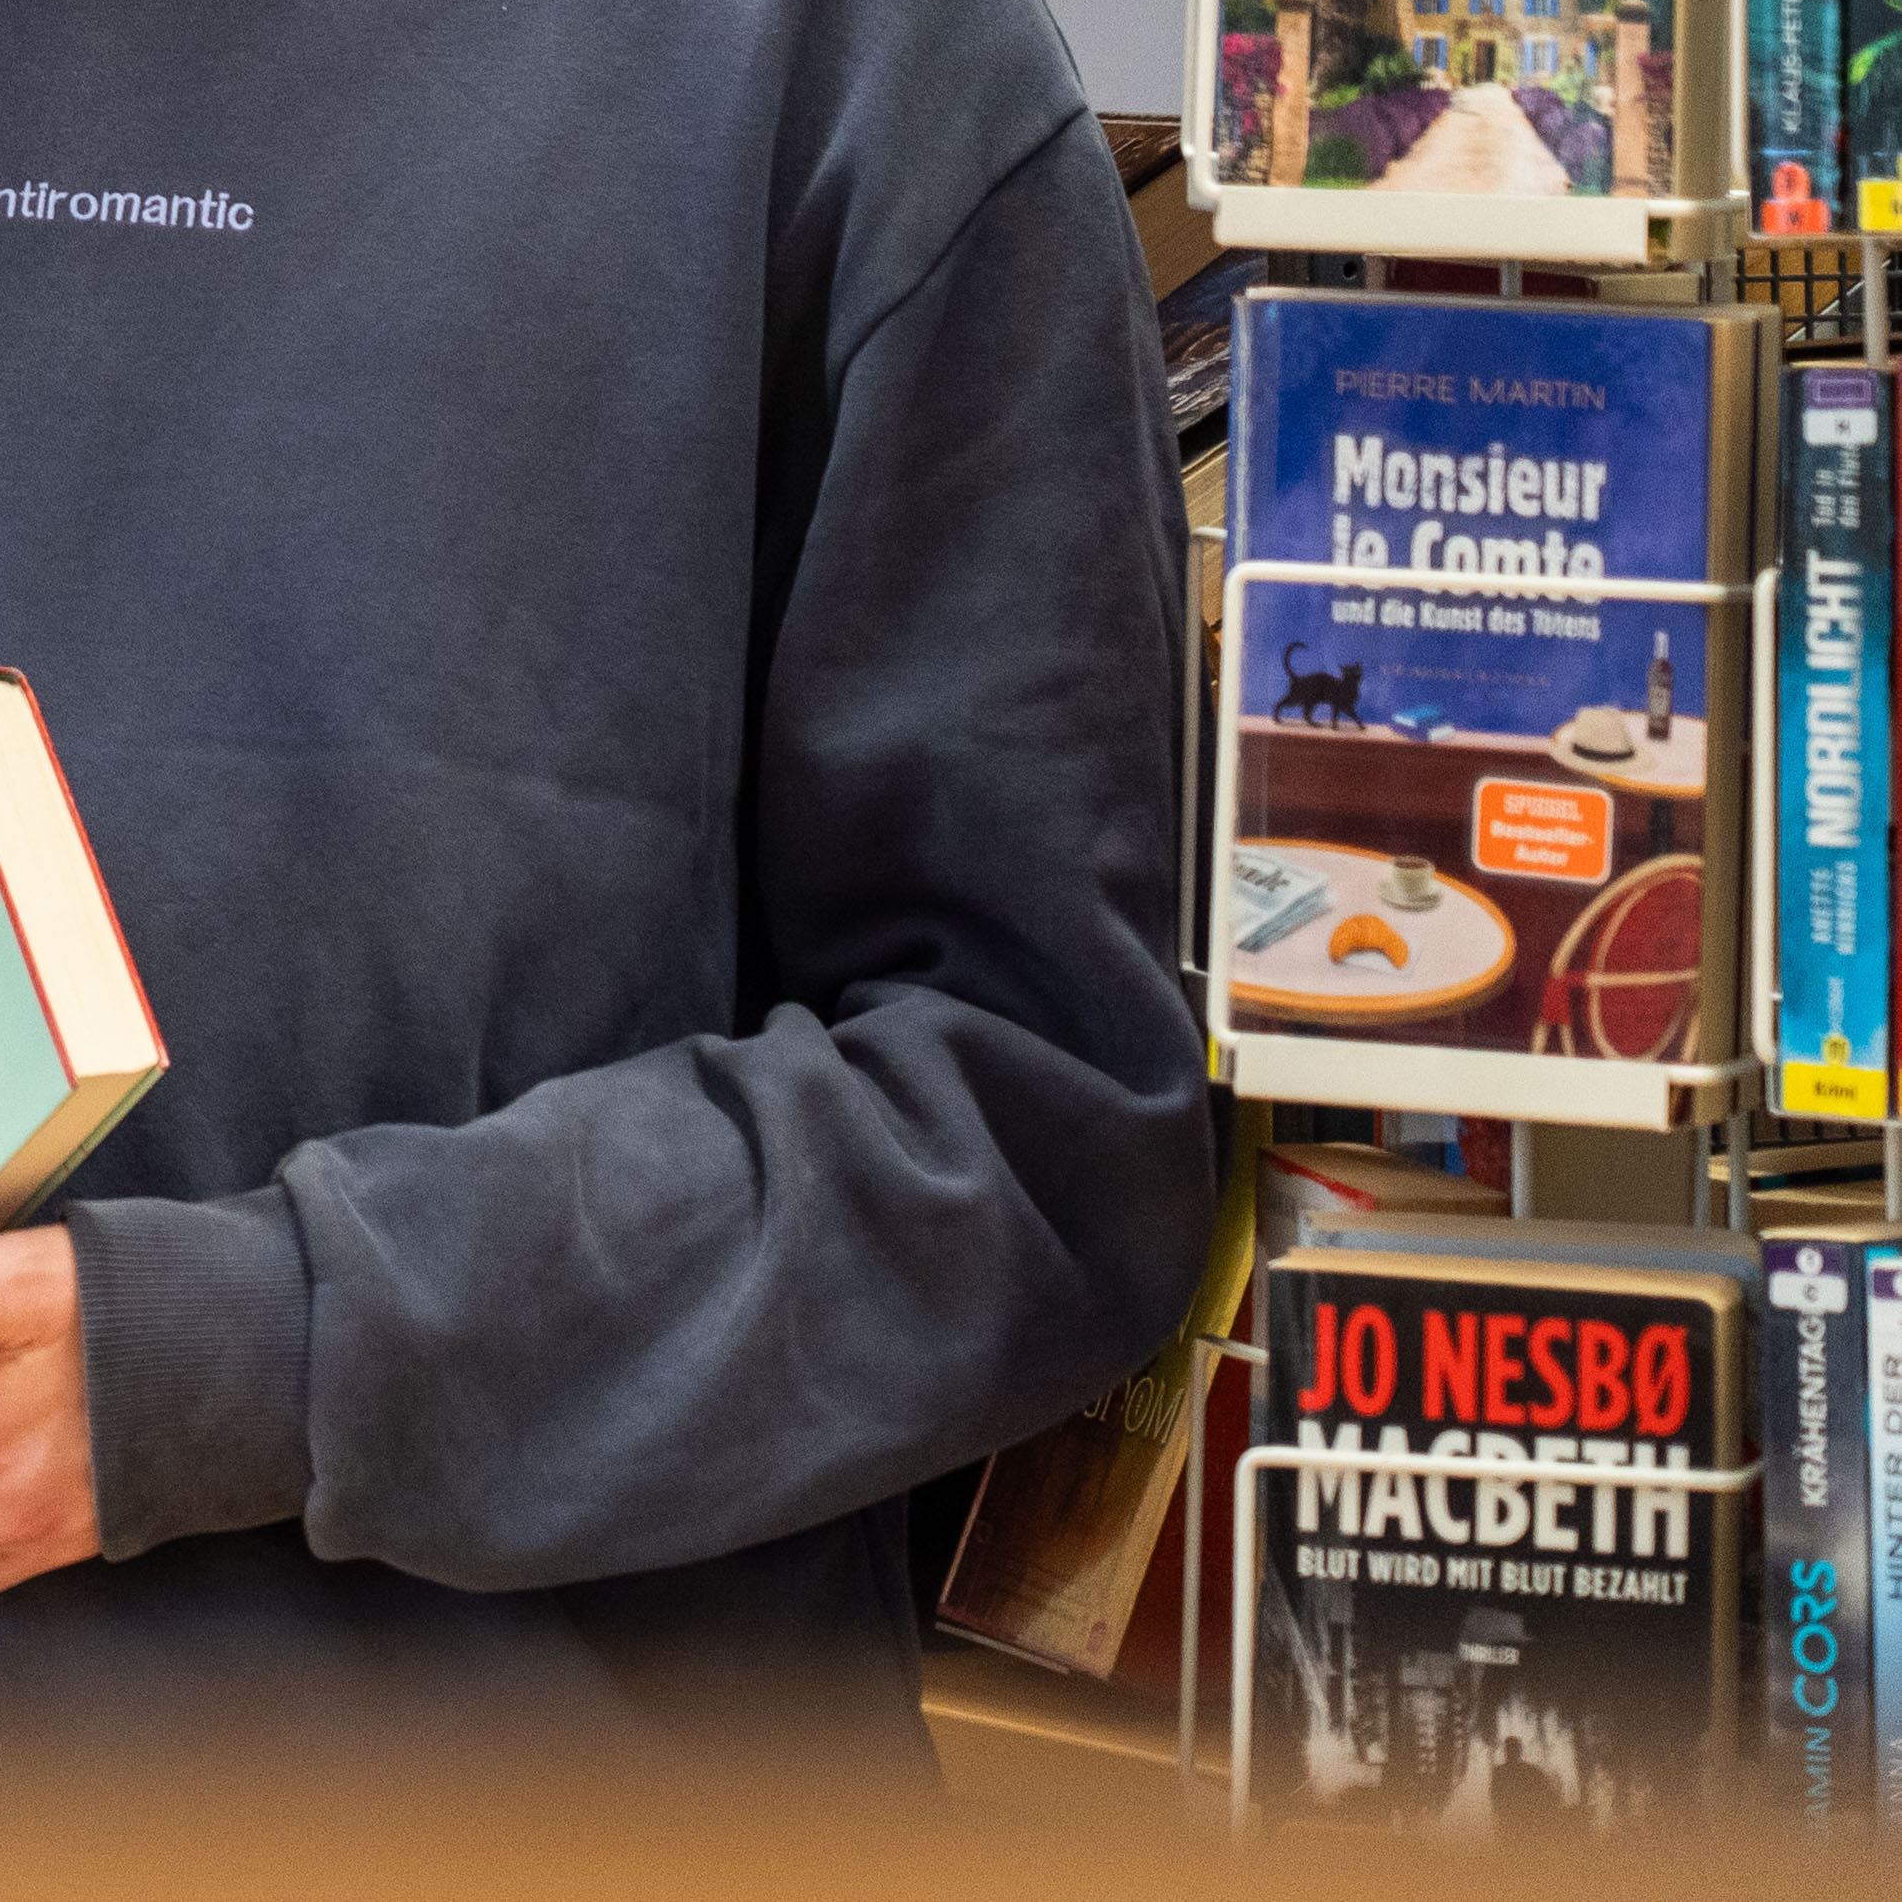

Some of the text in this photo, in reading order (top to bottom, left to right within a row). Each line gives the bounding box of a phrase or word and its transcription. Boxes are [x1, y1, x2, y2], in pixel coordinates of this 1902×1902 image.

[1335, 369, 1606, 411] PIERRE MARTIN
[1333, 434, 1607, 522] Monsieur
[1332, 514, 1606, 604] le Comte
[1332, 597, 1377, 626] und
[1380, 597, 1416, 628] die
[1419, 599, 1484, 632] Kunst
[1487, 604, 1527, 637] des
[1805, 548, 1864, 849] NORDLICHT
[1297, 1302, 1398, 1418] JO
[1422, 1309, 1690, 1437] NESBØ
[1793, 1311, 1828, 1507] KRÄHENTAG
[1297, 1419, 1689, 1560] MACBETH
[1882, 1455, 1902, 1599] HINTER
[1297, 1545, 1688, 1605] BLUT WIRD MIT BLUT BEZAHLT
[1790, 1559, 1839, 1831] AMIN CORS
